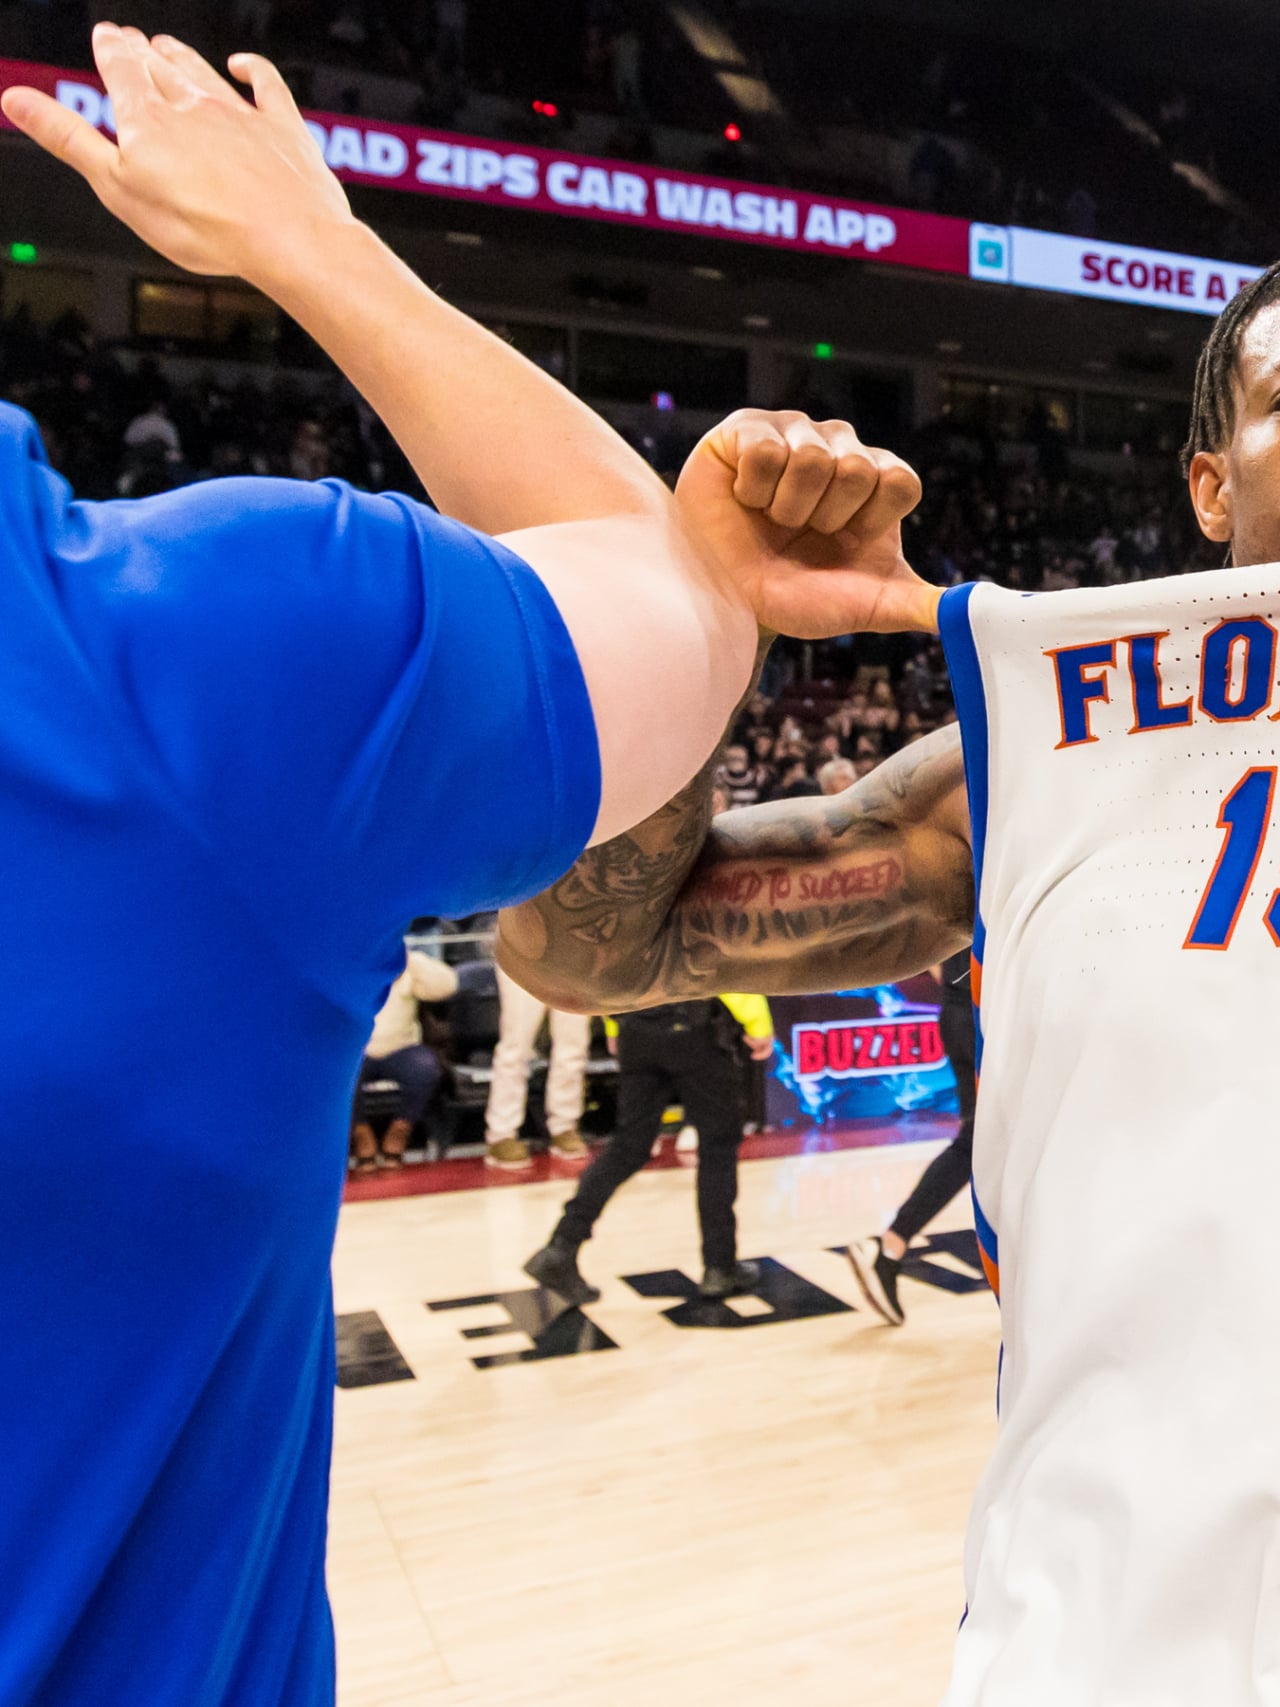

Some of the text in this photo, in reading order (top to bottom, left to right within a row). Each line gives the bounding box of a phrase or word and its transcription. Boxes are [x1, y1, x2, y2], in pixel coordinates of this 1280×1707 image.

[416, 139, 538, 198] ZIPS
[546, 161, 647, 216] CAR
[654, 178, 797, 238] WASH
[804, 204, 896, 252] APP
[1081, 252, 1196, 298] SCORE
[1206, 273, 1227, 302] A
[799, 857, 902, 901] SUCCEED
[798, 1020, 946, 1075] BUZZED
